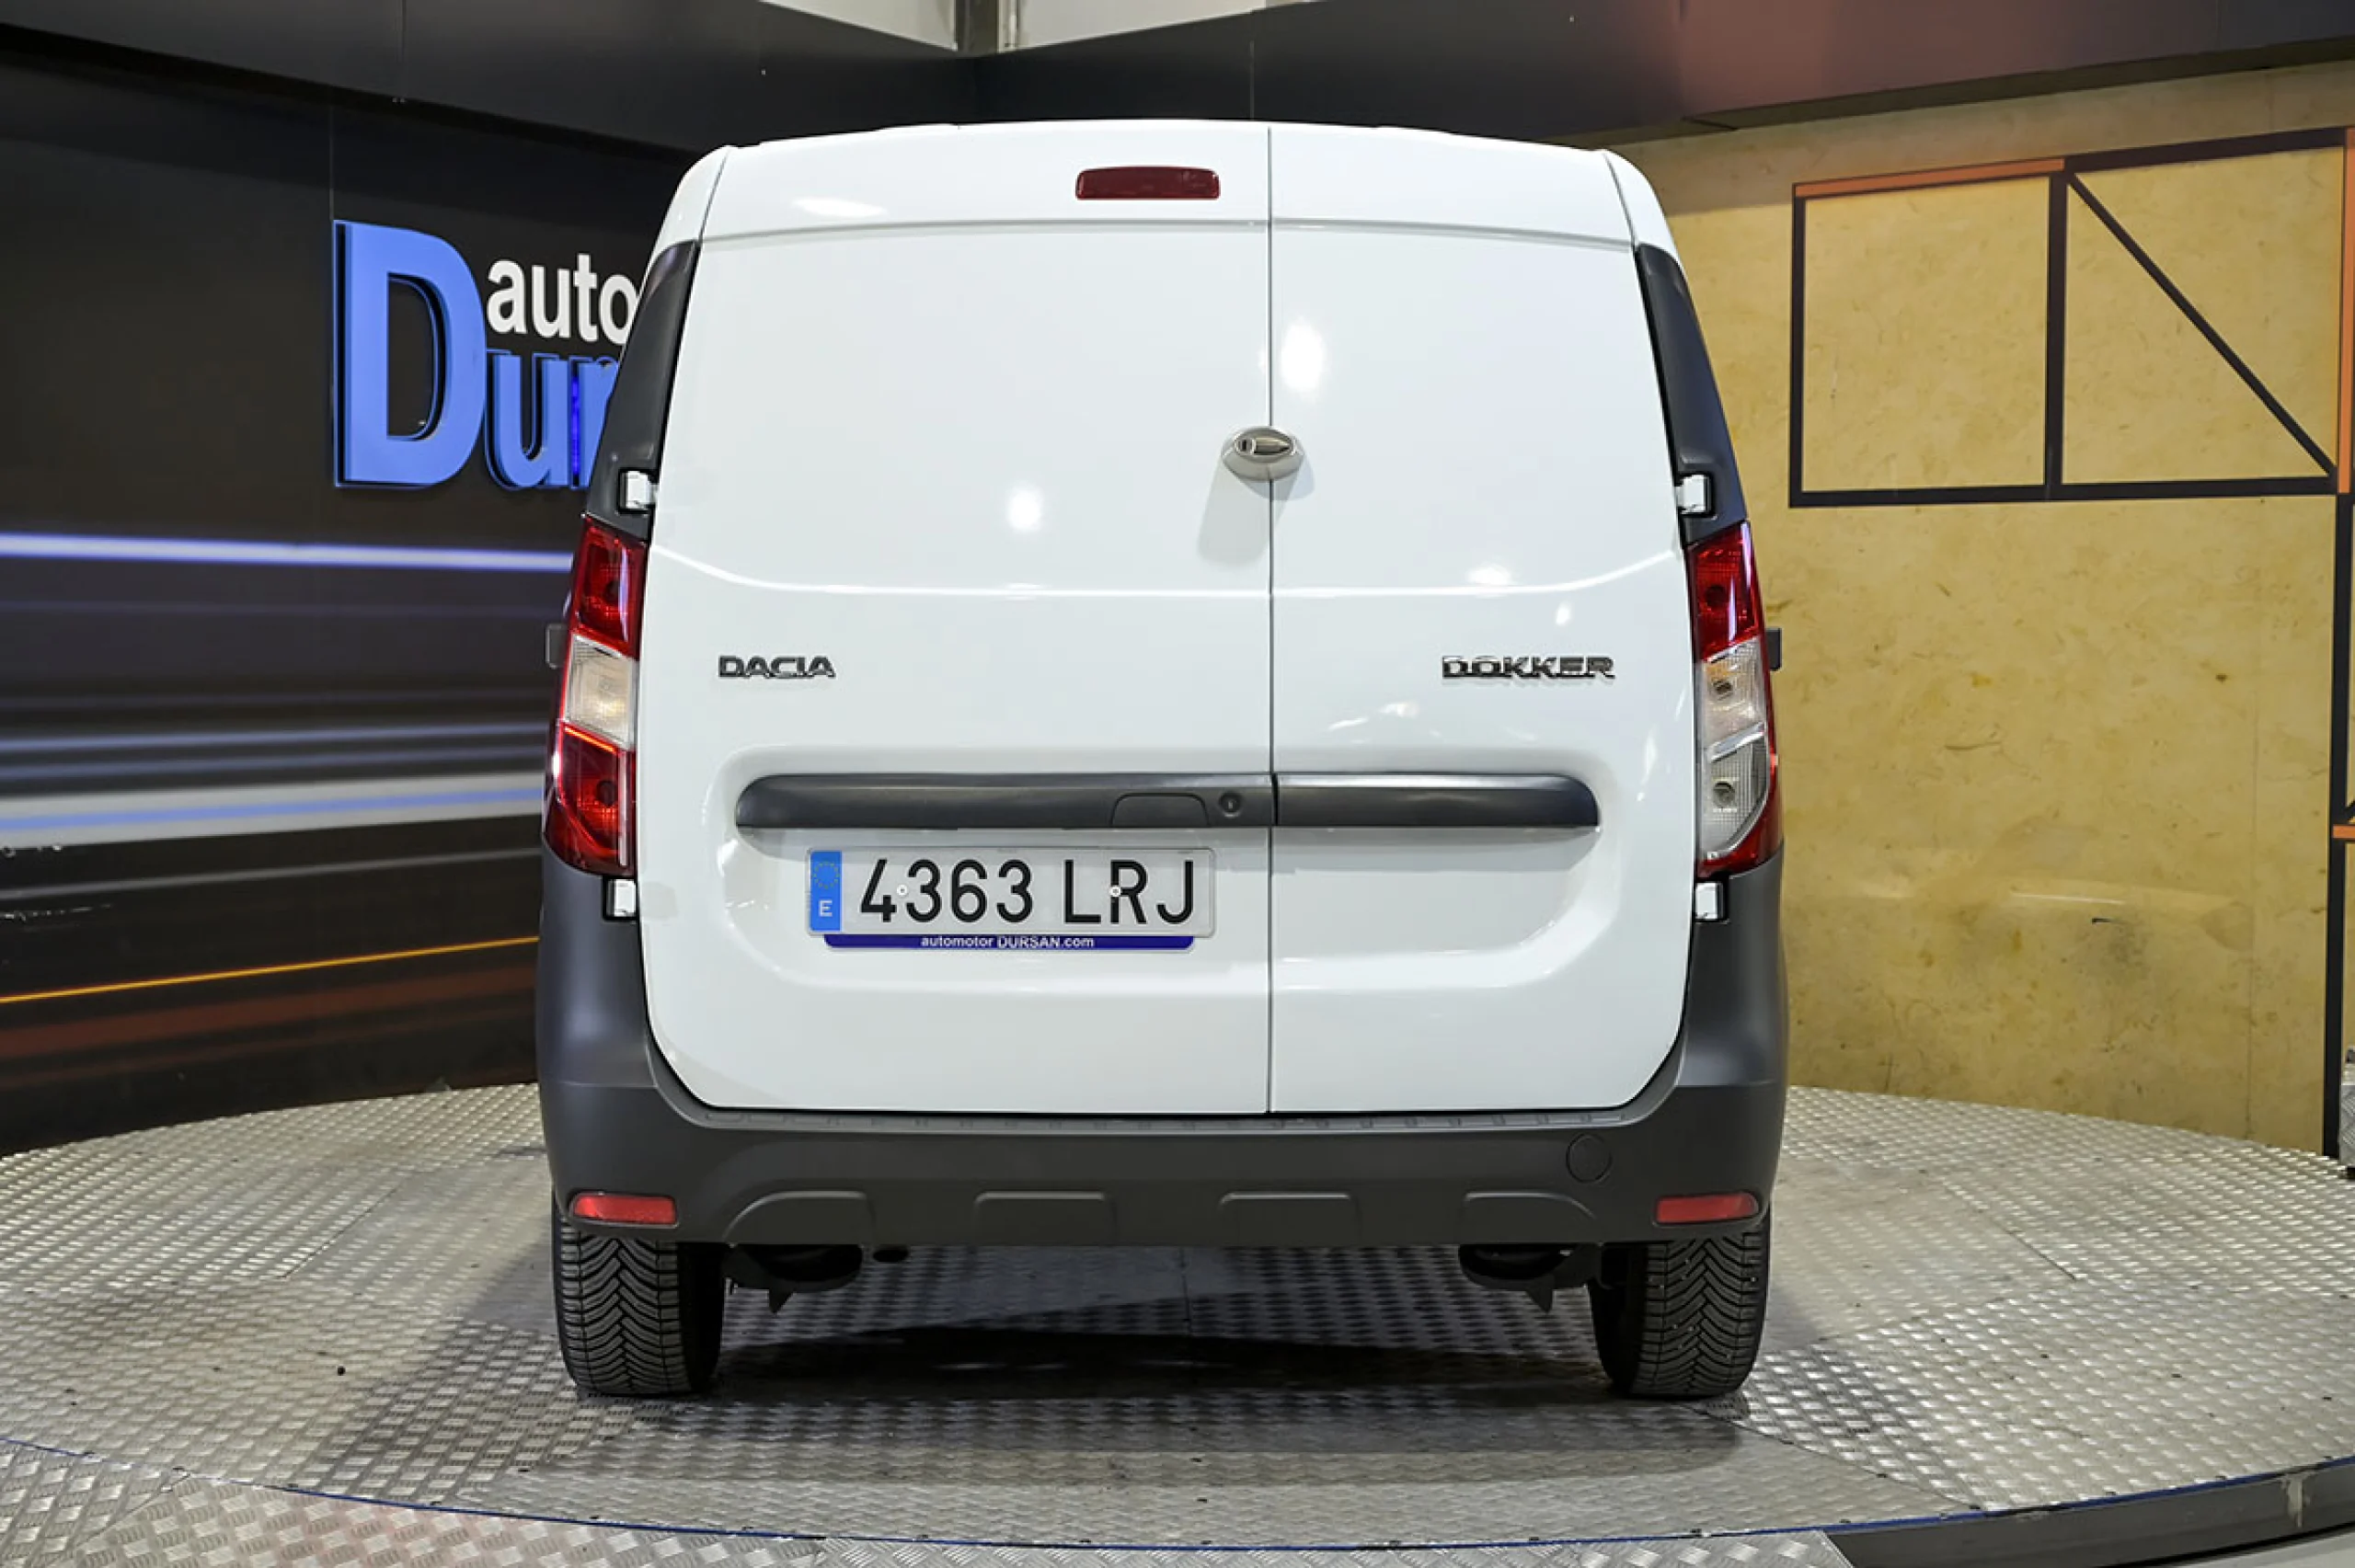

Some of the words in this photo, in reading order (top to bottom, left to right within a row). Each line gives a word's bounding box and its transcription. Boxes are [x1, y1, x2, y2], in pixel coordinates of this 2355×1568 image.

[487, 253, 638, 345] auto
[718, 655, 836, 679] DACIA
[1442, 656, 1615, 679] DOKKER
[860, 858, 1033, 923] 4363
[1063, 859, 1194, 924] LRJ
[818, 900, 833, 917] E
[922, 935, 994, 947] automotor
[997, 935, 1095, 948] DURSAN.com
